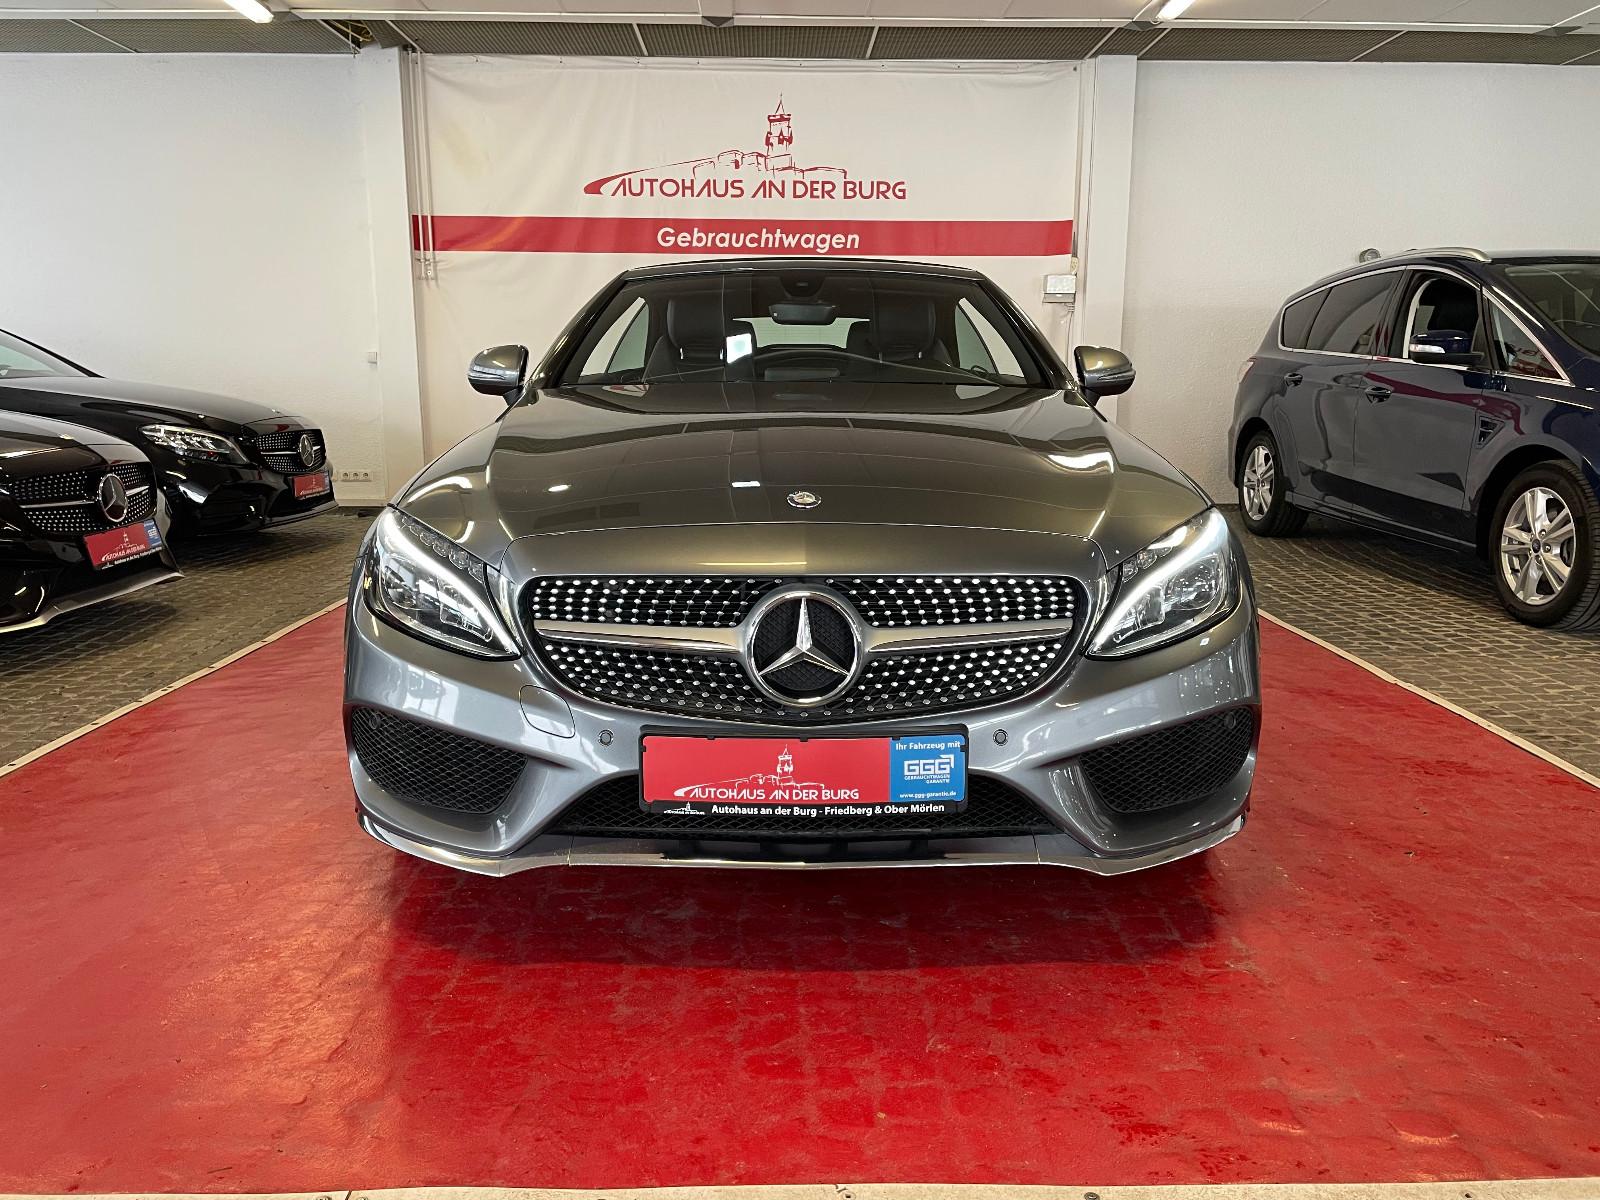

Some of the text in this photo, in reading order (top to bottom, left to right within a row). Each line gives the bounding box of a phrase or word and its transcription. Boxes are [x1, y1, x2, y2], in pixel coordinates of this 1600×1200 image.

[611, 178, 907, 200] AUTOHAUS AN DER BURG
[657, 227, 860, 254] Gebrauchtwagen
[895, 740, 961, 751] Ihr Fahrzeug mit
[904, 758, 951, 776] GGG
[689, 787, 860, 801] AUTOHAUS AN DER BURG
[711, 804, 759, 815] Autohaus
[760, 807, 773, 815] an
[774, 805, 792, 816] der
[793, 806, 817, 818] Burg
[824, 805, 873, 817] Friedberg
[874, 805, 883, 814] &
[884, 804, 909, 814] Ober
[910, 803, 945, 813] Mörlen
